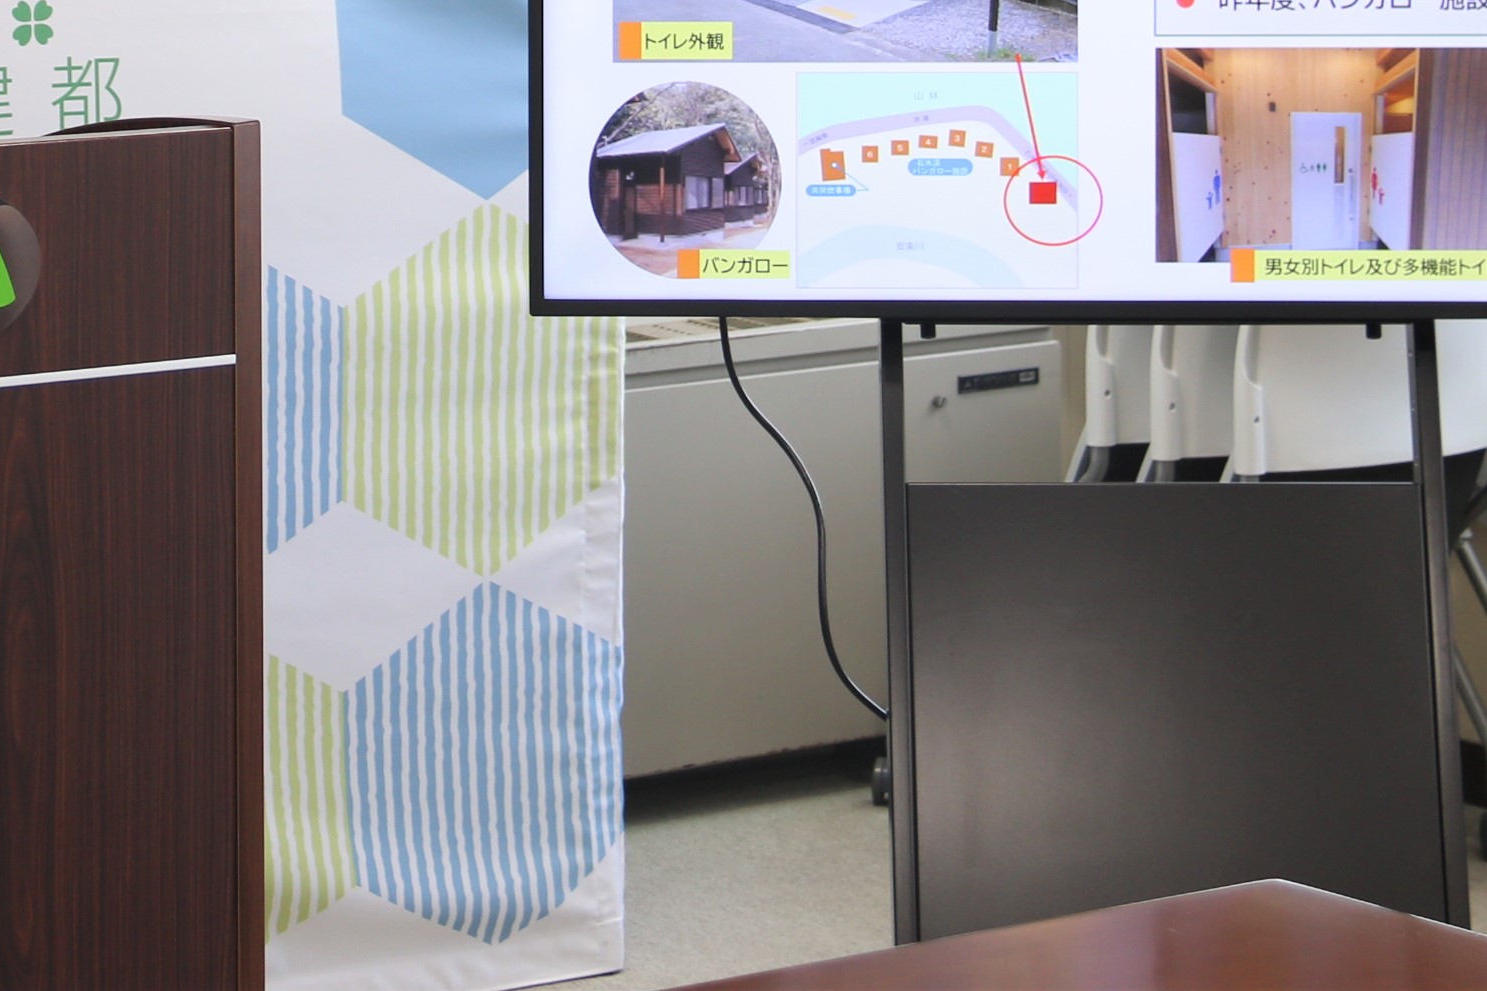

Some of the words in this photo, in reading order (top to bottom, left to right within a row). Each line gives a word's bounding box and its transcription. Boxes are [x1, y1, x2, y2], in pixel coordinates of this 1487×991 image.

[644, 32, 724, 50] トイレ外観
[702, 257, 789, 274] バンガロー
